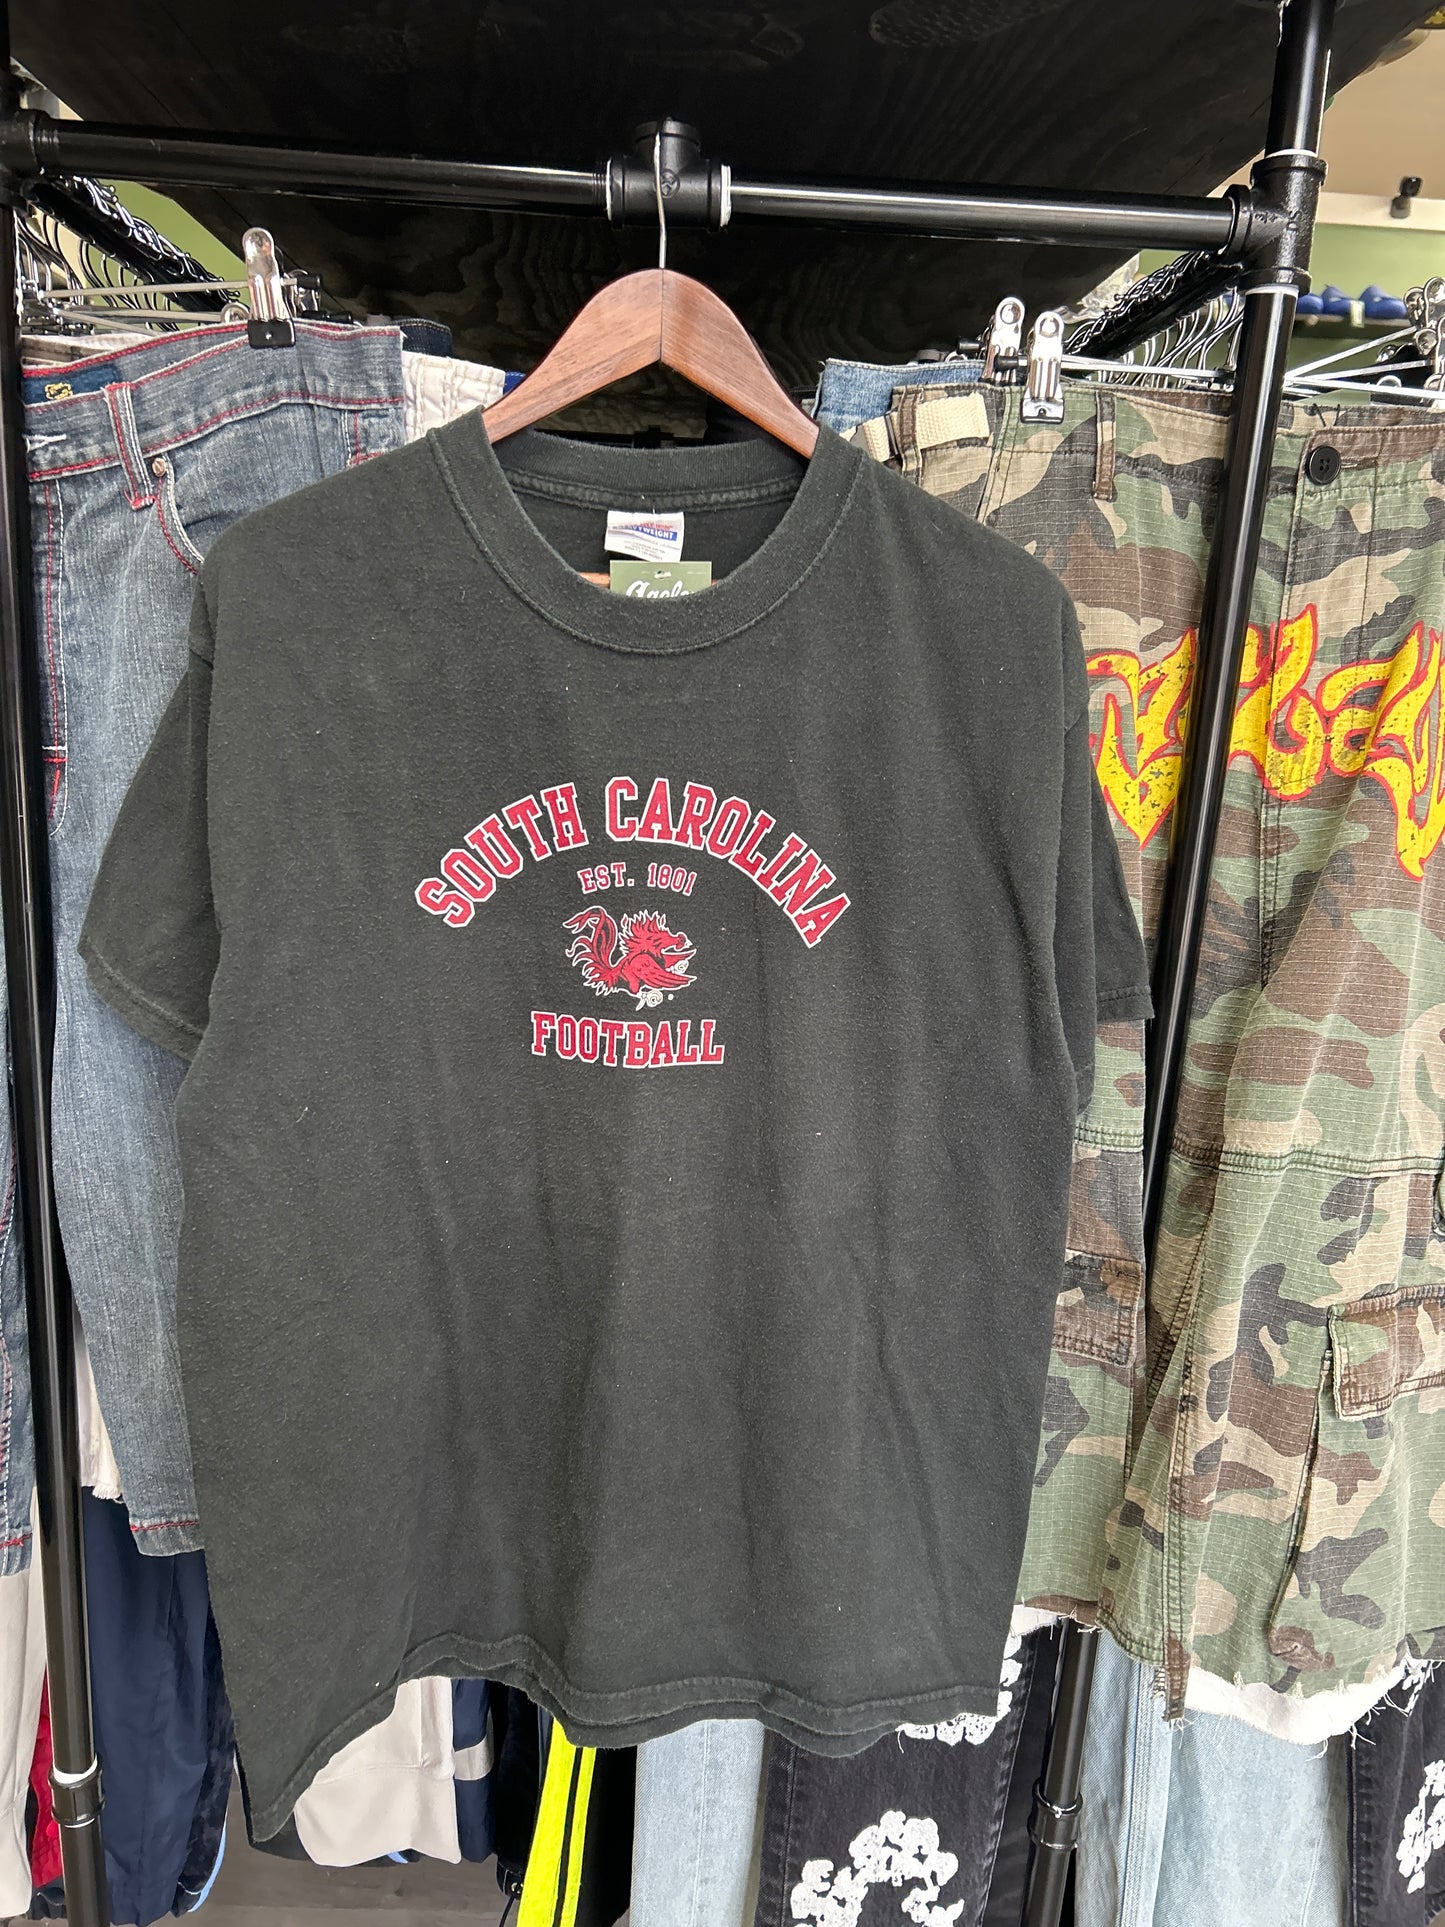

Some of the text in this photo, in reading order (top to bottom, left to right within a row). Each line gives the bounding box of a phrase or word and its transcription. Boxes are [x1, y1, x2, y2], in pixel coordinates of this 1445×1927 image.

[415, 776, 851, 948] SOUTH CAROLINA
[577, 862, 697, 896] EST. 1801
[531, 1011, 725, 1069] FOOTBALL
